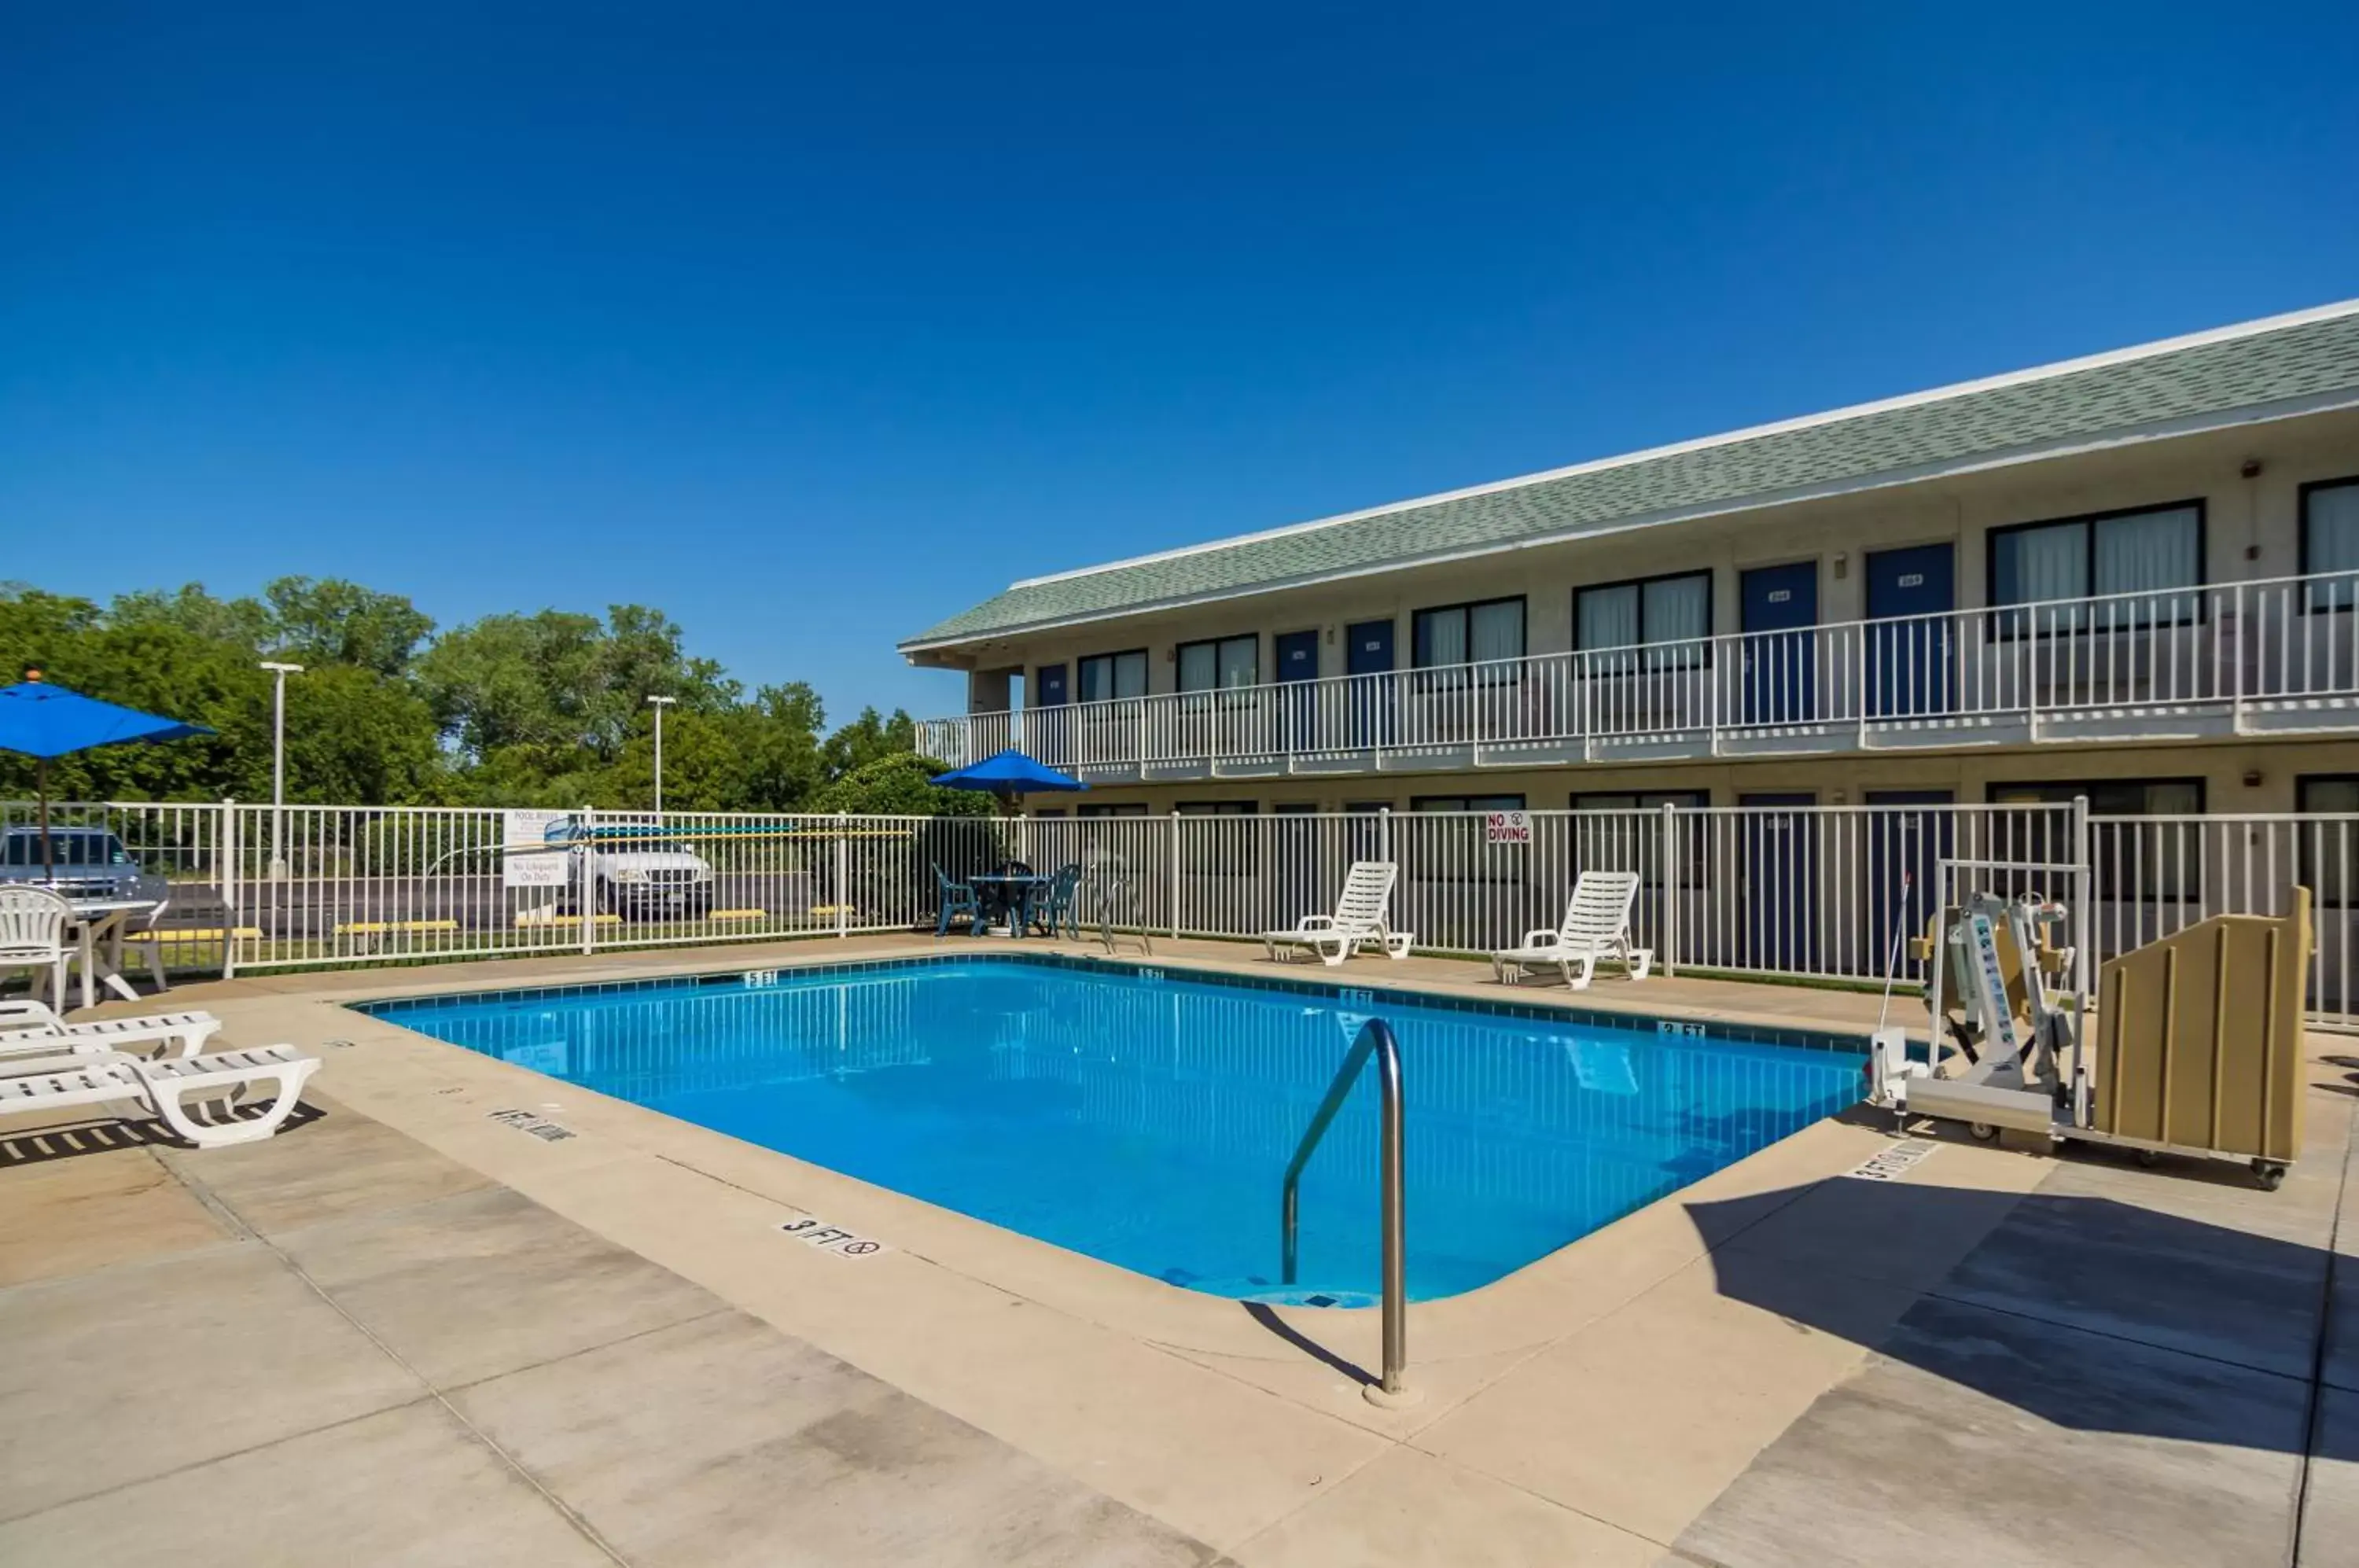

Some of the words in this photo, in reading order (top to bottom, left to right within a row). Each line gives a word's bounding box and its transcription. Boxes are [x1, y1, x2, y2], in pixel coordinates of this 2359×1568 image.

[1488, 813, 1505, 826] NO
[1488, 827, 1529, 841] DIVING
[782, 1220, 818, 1231] 3
[796, 1226, 855, 1245] FT
